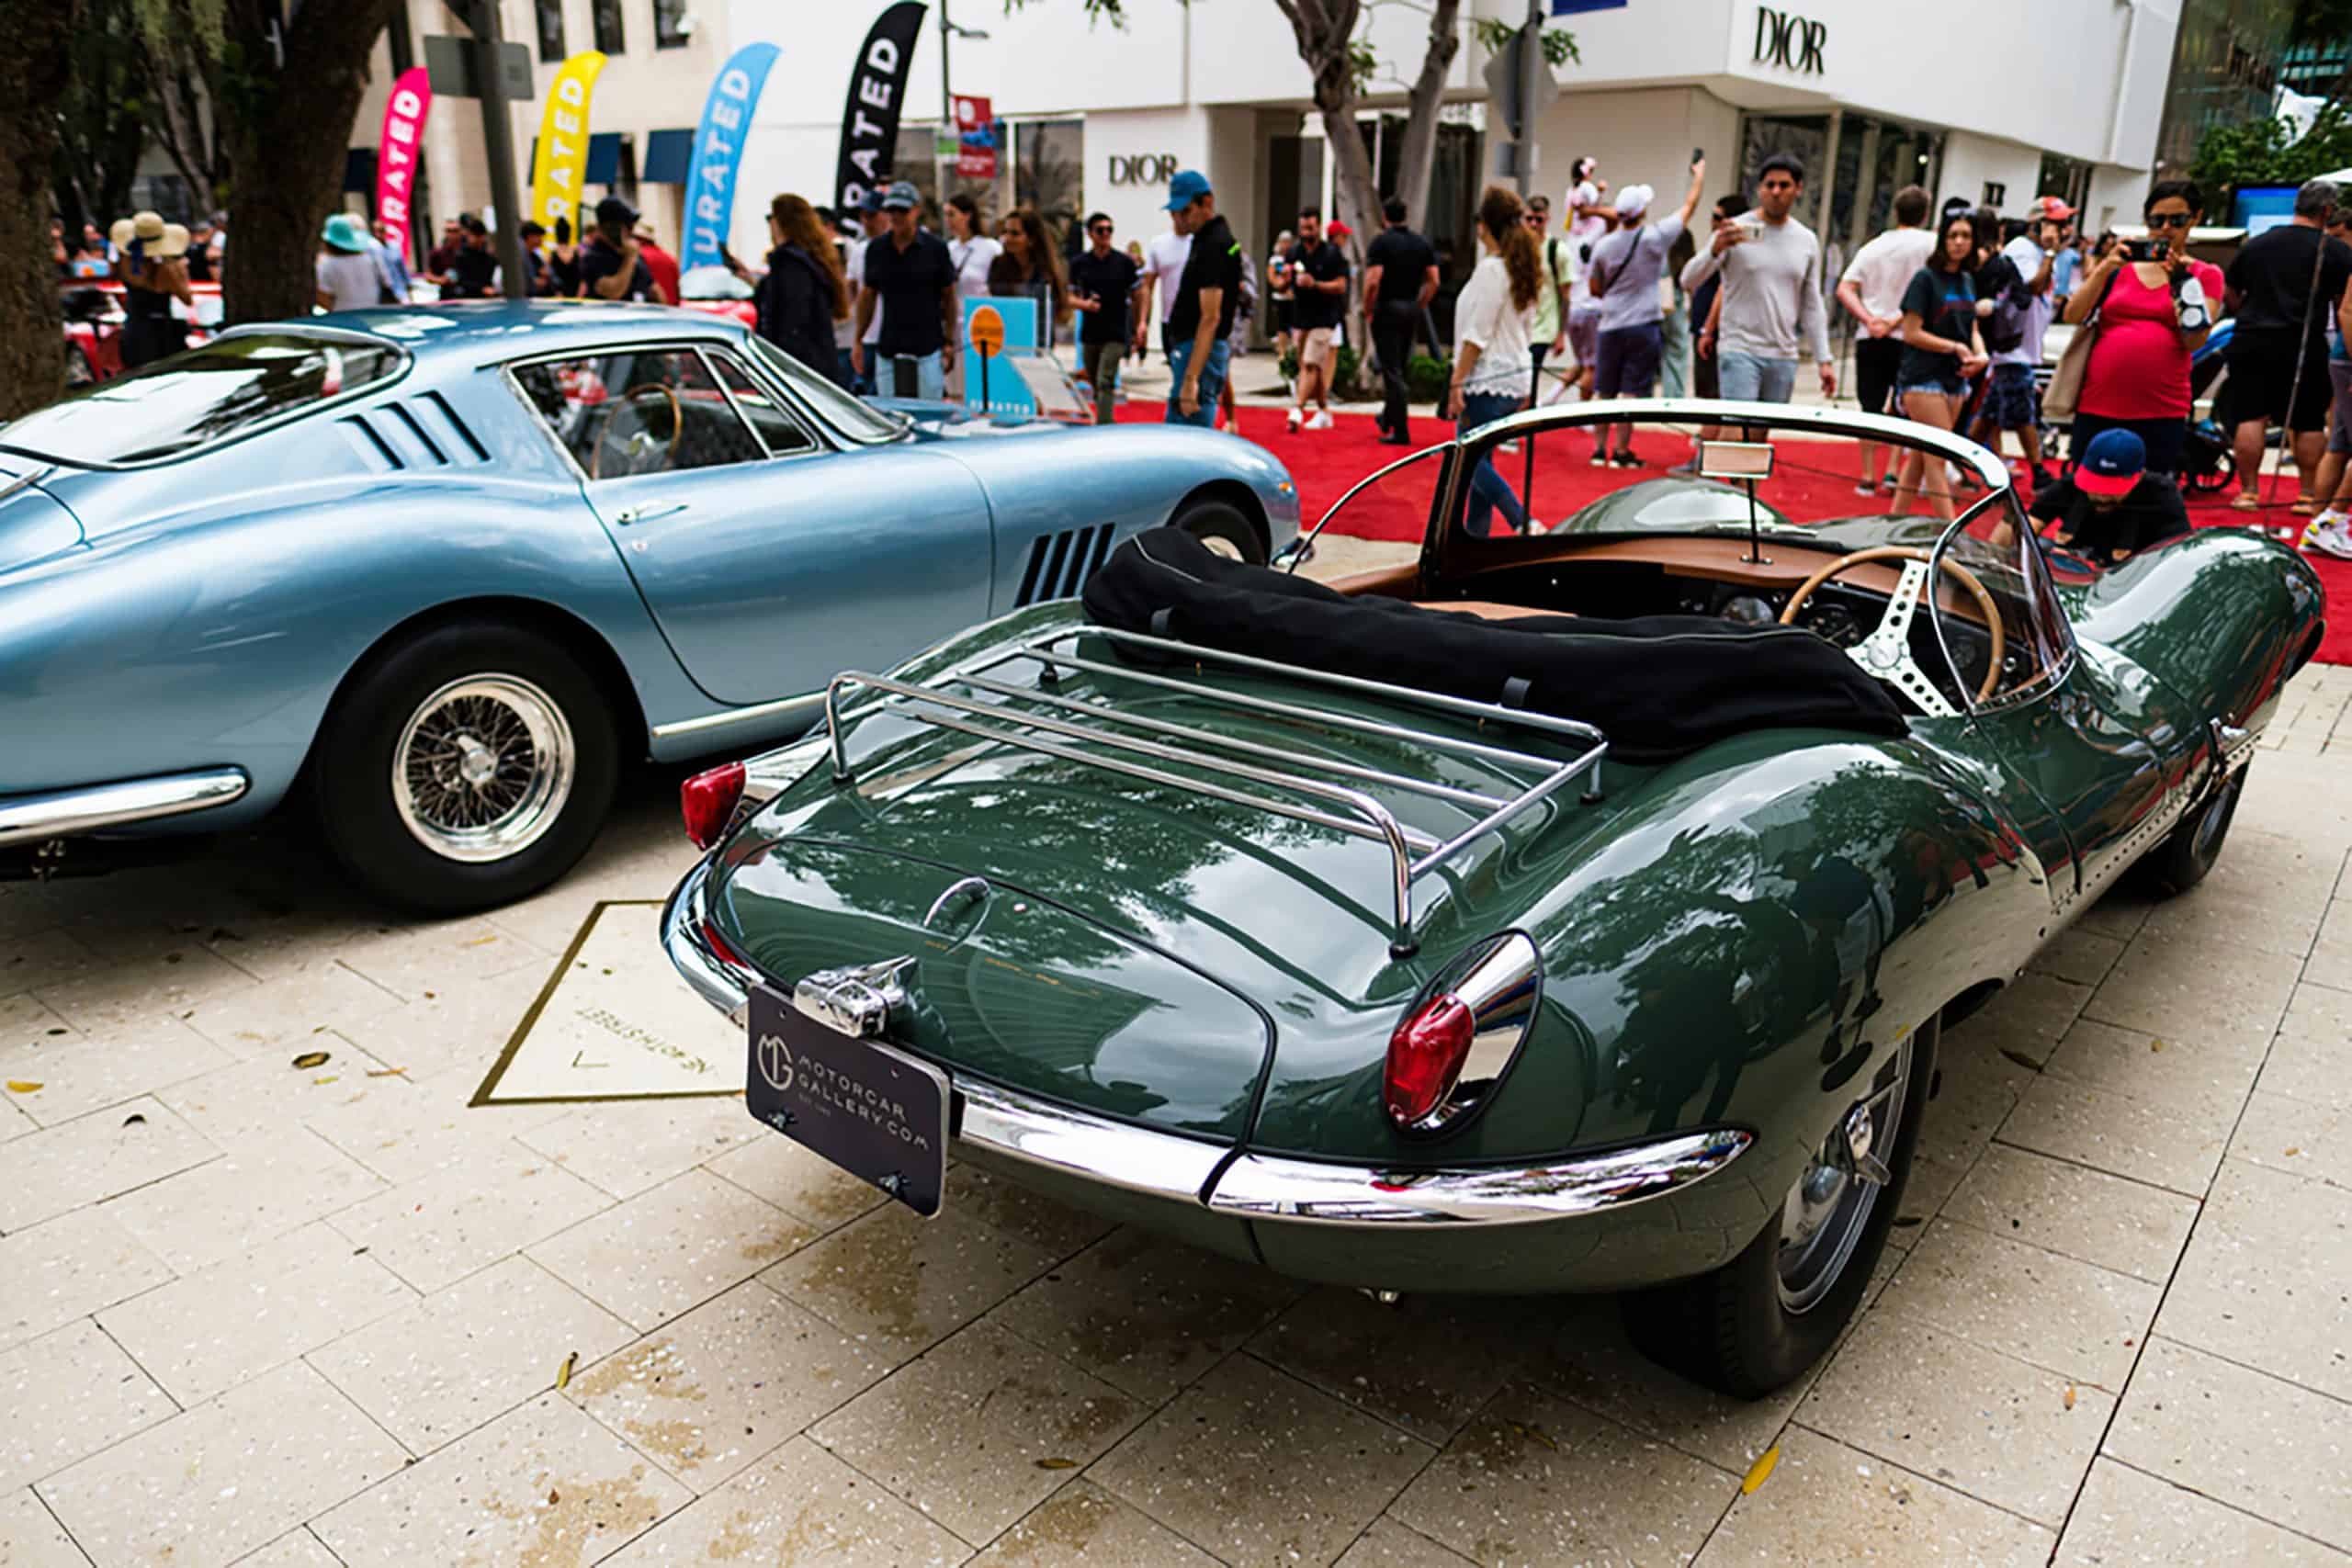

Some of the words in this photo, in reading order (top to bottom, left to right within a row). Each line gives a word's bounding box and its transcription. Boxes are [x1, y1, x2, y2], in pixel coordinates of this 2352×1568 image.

[1753, 6, 1826, 74] DIOR
[382, 89, 422, 246] URATED
[544, 77, 583, 250] RATED
[693, 69, 752, 267] URATED
[841, 37, 899, 238] URATED
[1109, 153, 1179, 186] DIOR
[797, 1073, 930, 1151] GALLERY.COM
[798, 1055, 906, 1122] MOTORCAR
